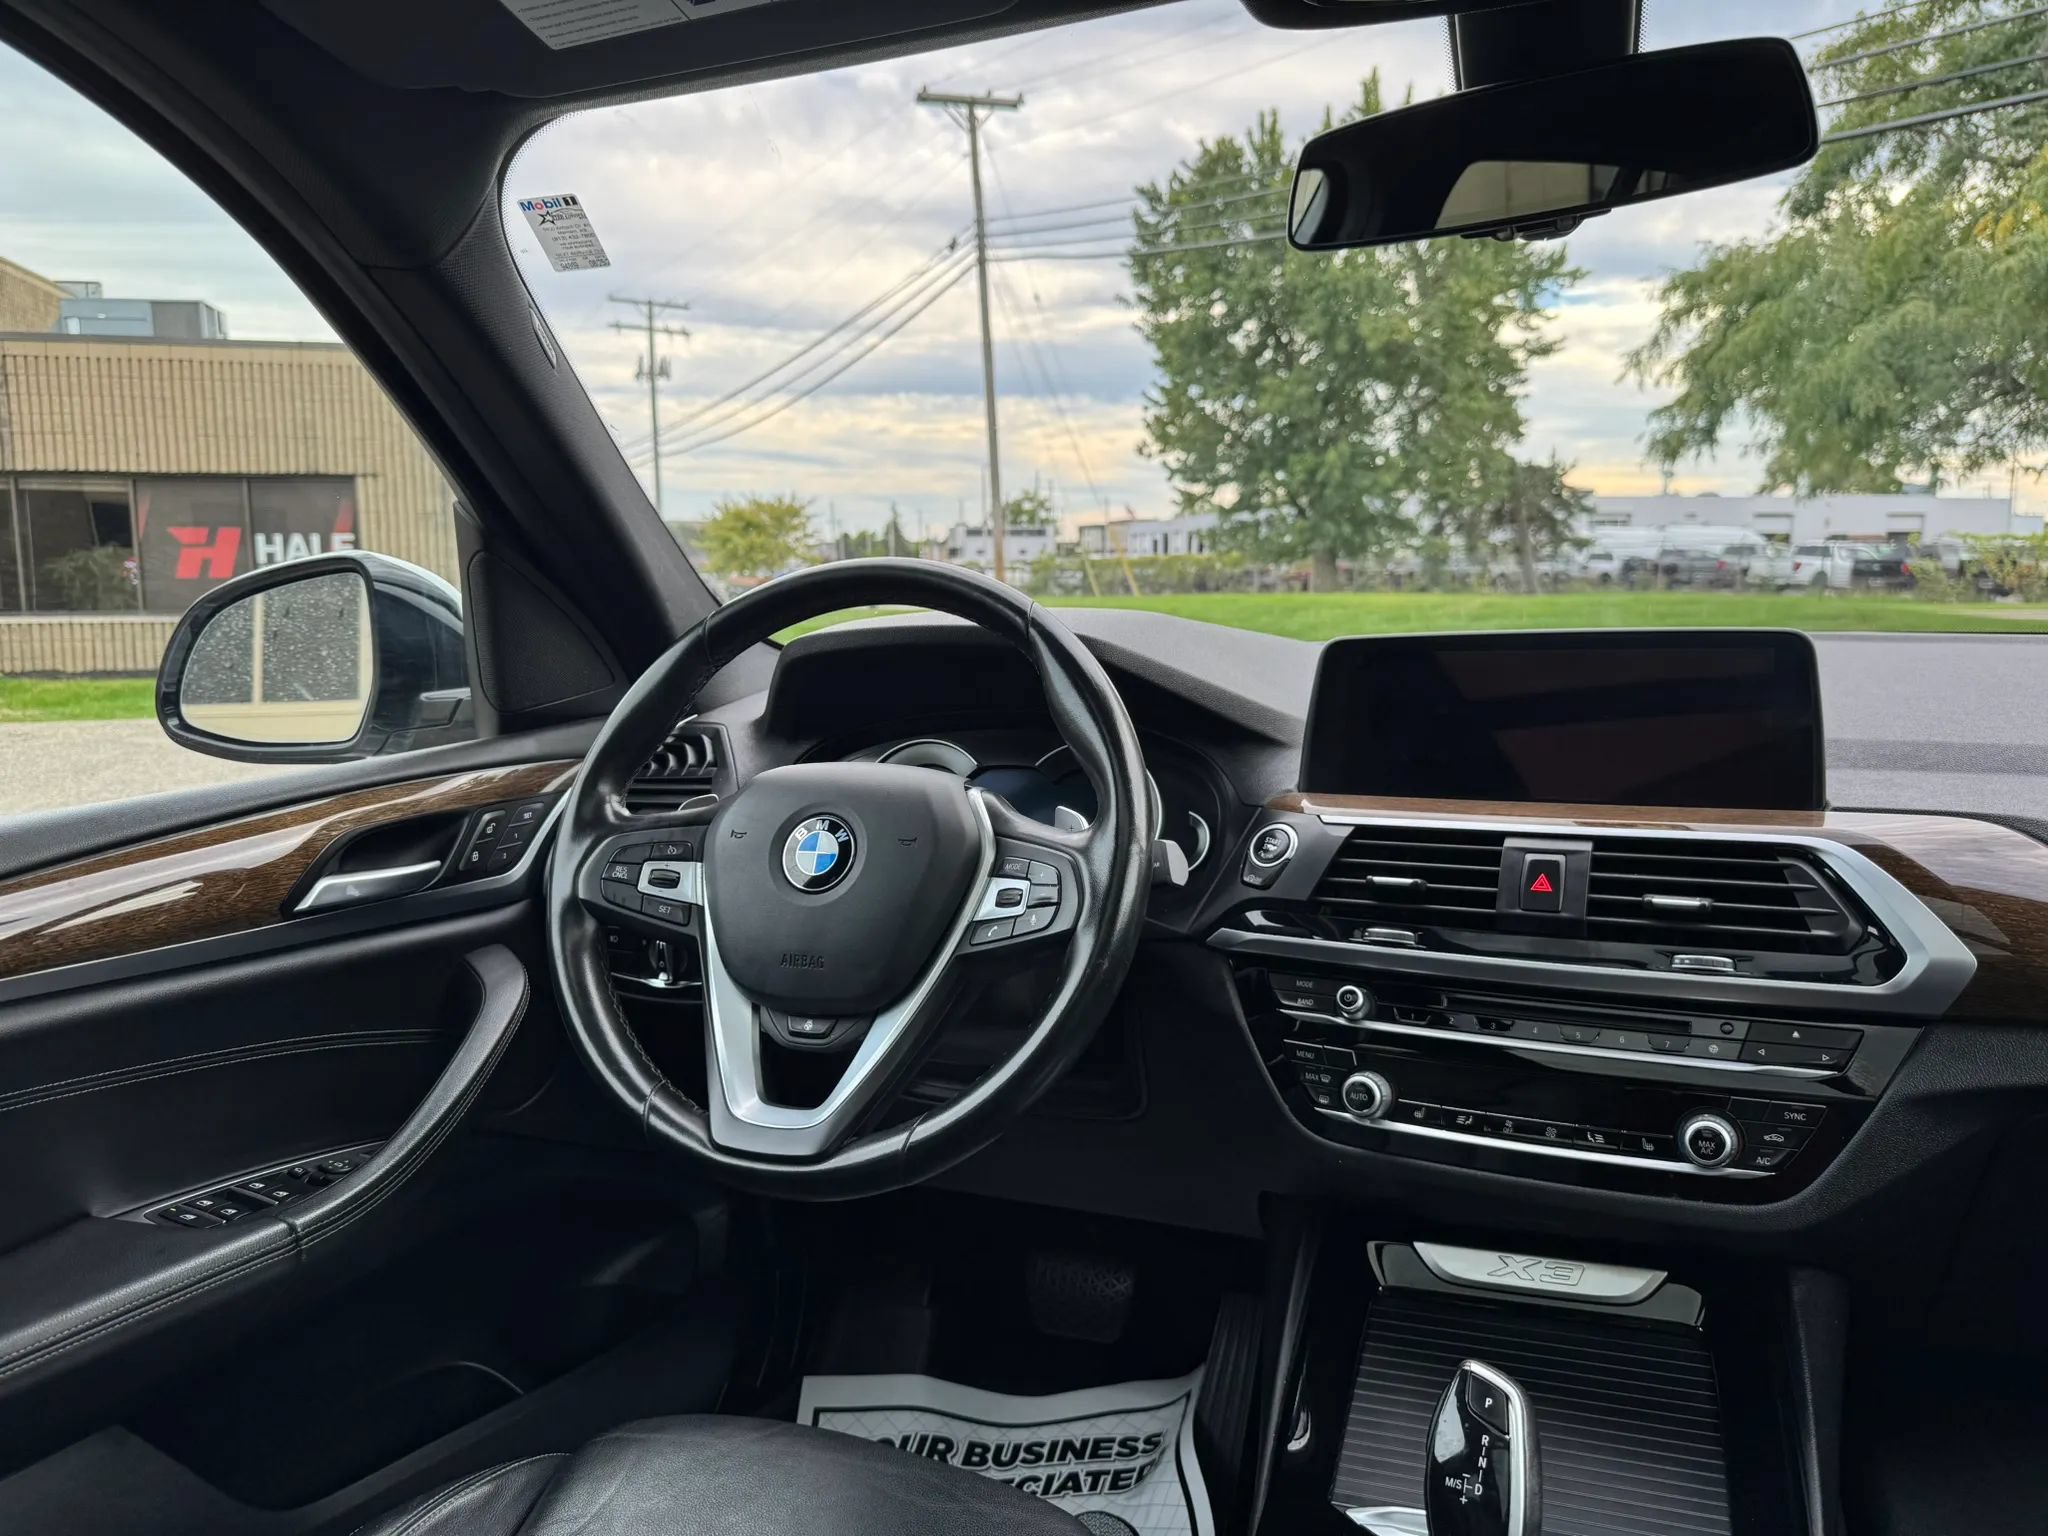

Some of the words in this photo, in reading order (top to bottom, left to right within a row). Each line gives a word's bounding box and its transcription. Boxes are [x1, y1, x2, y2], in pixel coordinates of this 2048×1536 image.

[520, 197, 562, 211] Mobil
[795, 819, 849, 843] BMW
[615, 865, 628, 873] RES
[1004, 863, 1022, 871] MODE
[658, 904, 672, 914] SET
[780, 953, 825, 969] AIRBAG
[1296, 980, 1313, 988] MODE
[1296, 998, 1314, 1006] BAND
[1449, 1017, 1455, 1025] 2
[1490, 1022, 1496, 1030] 3
[1532, 1026, 1539, 1034] 4
[1575, 1032, 1581, 1040] 5
[1619, 1036, 1625, 1044] 6
[1665, 1040, 1671, 1049] 7
[1296, 1050, 1315, 1059] MENU
[1305, 1072, 1319, 1081] MAX
[1350, 1092, 1368, 1101] AUTO
[1784, 1111, 1807, 1121] SYNC
[1698, 1140, 1716, 1149] MAX
[1700, 1147, 1714, 1156] A/C
[1756, 1156, 1771, 1166] A/C
[1487, 1254, 1586, 1286] X3
[1485, 1397, 1493, 1409] P
[1481, 1434, 1490, 1447] R
[876, 1432, 956, 1465] UR
[961, 1430, 1165, 1468] BUSINESS
[1478, 1456, 1487, 1469] N
[1444, 1476, 1462, 1490] M/S
[1474, 1483, 1483, 1496] D
